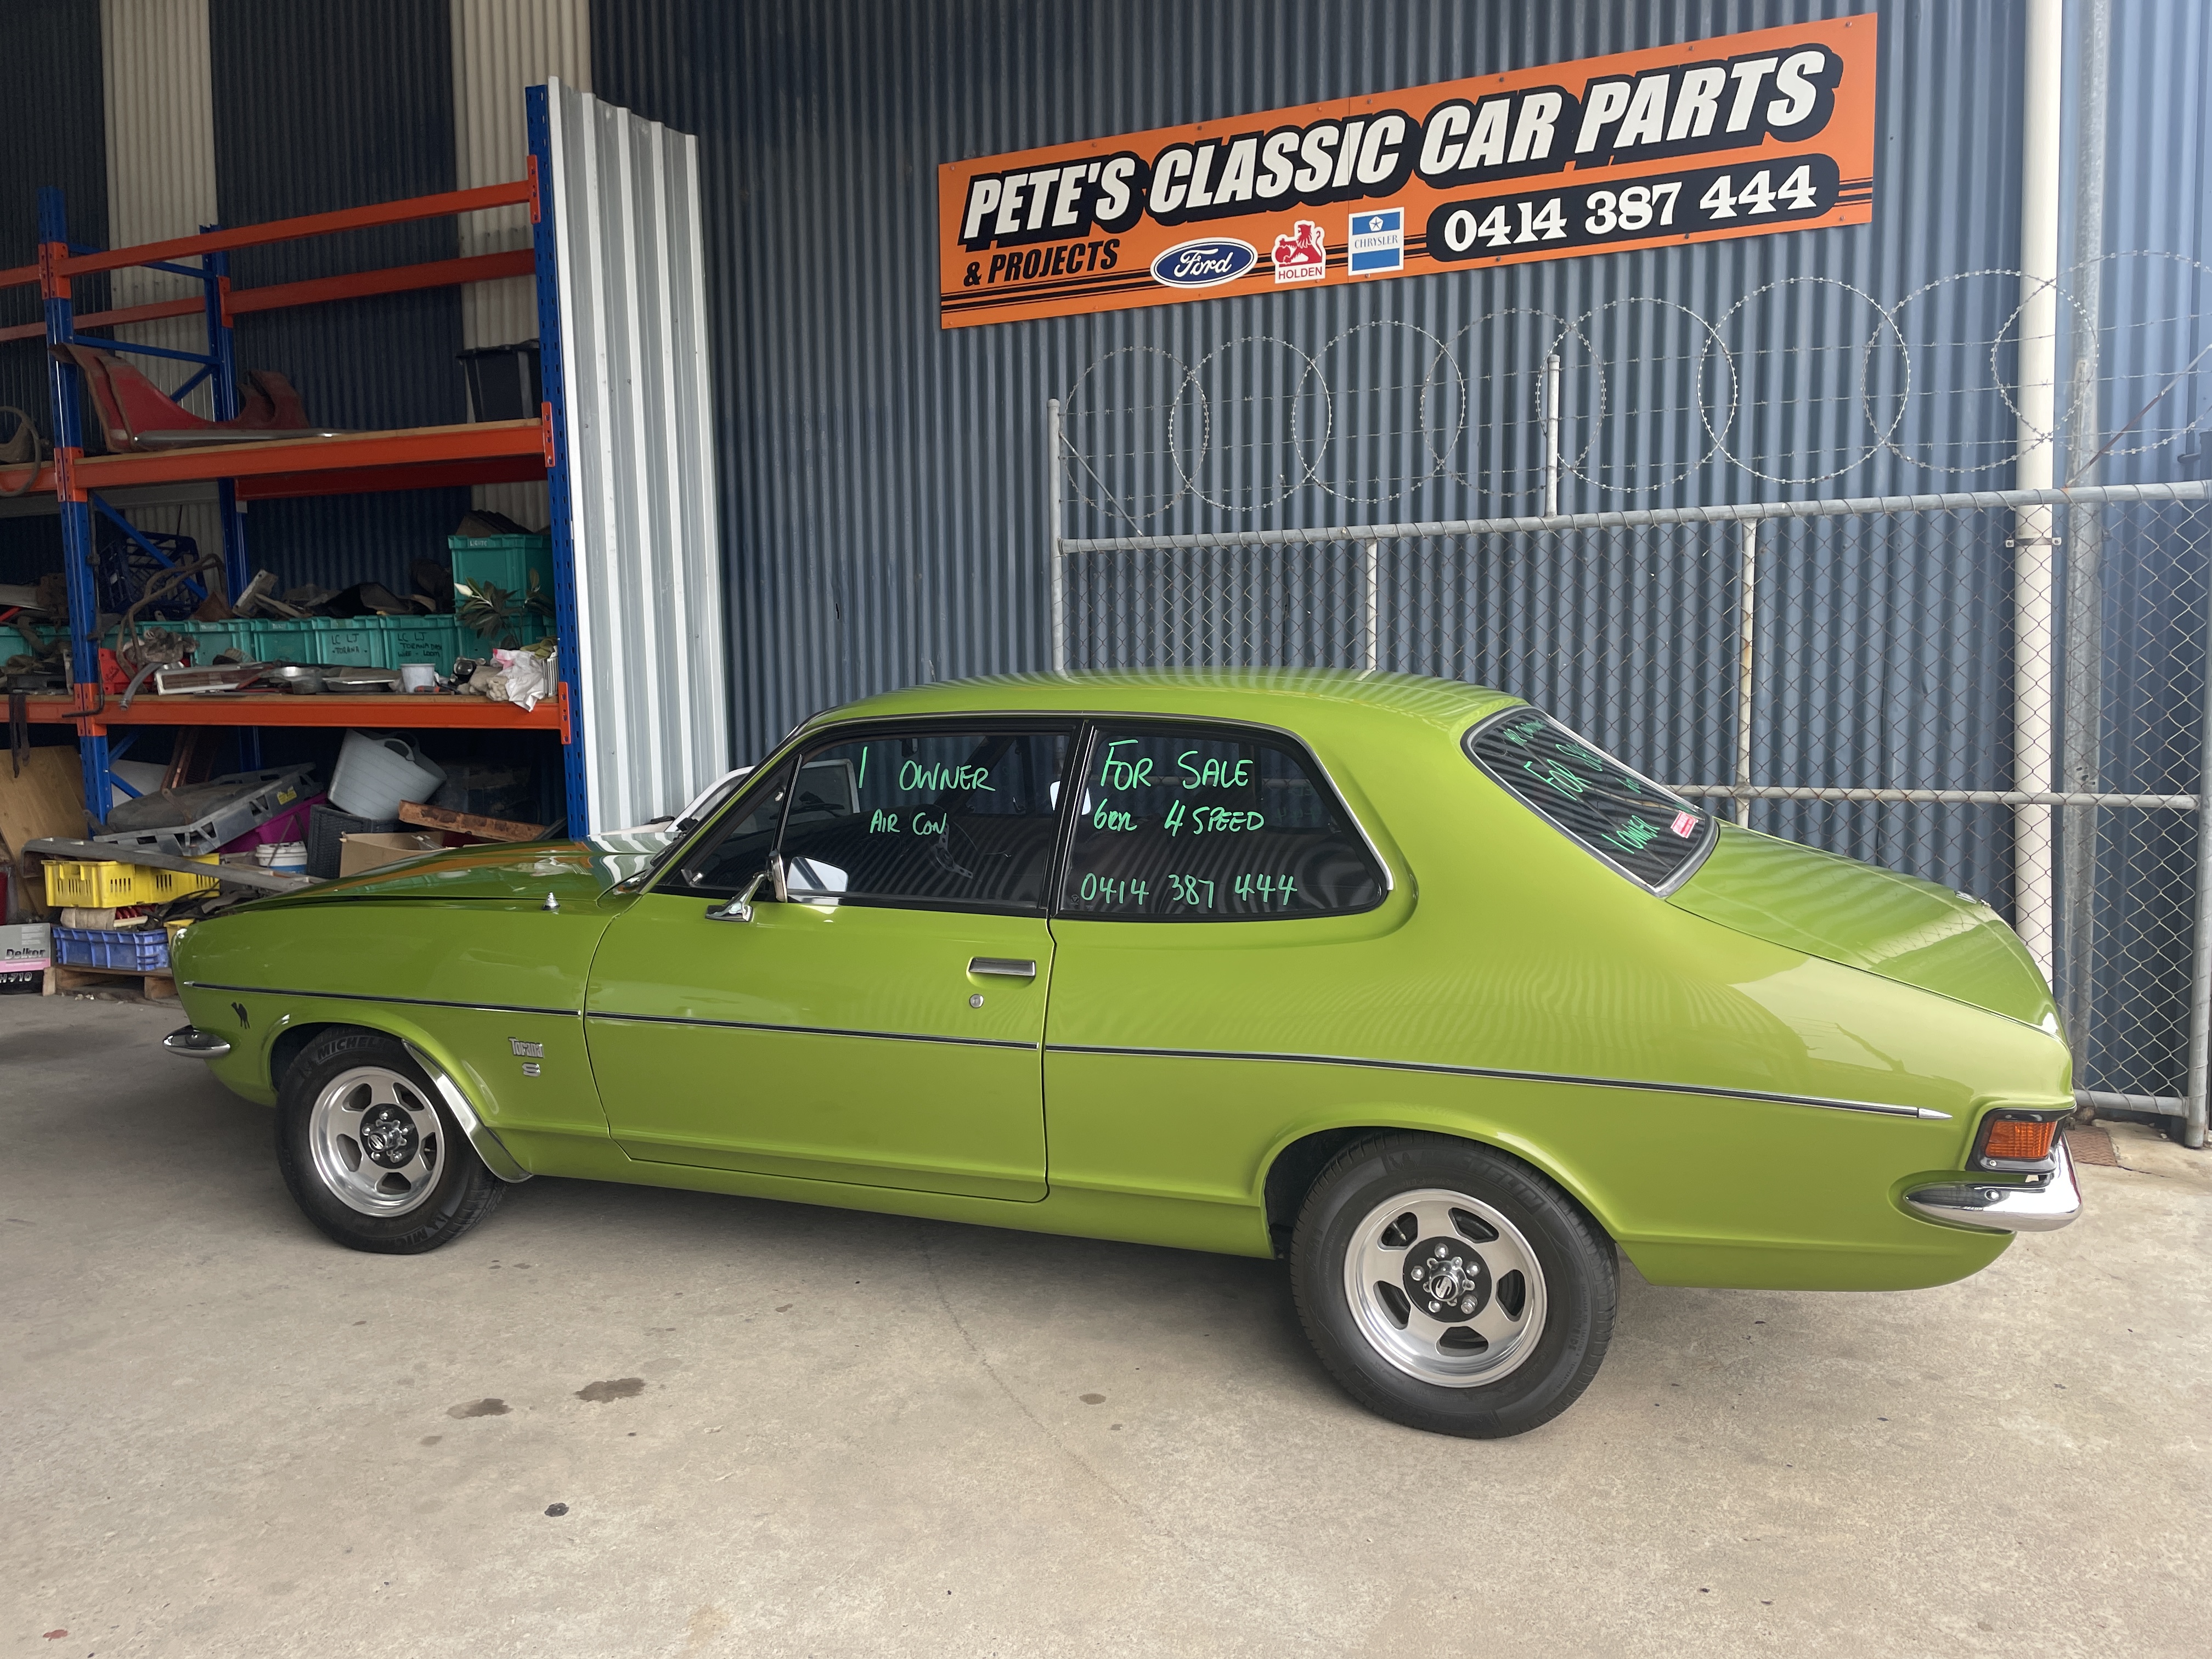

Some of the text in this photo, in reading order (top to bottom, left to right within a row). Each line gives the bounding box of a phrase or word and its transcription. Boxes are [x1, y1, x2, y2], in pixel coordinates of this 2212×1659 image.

[963, 50, 1826, 239] PETE'S CLASSIC CAR PARTS
[1443, 164, 1818, 252] 0414 387 444
[1354, 235, 1398, 249] CHRYSLER
[963, 238, 1120, 287] & PROJECTS
[1174, 248, 1233, 277] Ford
[1278, 266, 1323, 280] HOLDEN
[899, 760, 996, 791] OWNER
[1100, 739, 1253, 791] FOR SALE
[870, 809, 900, 833] AIR
[1164, 799, 1186, 837] 4
[1192, 806, 1265, 834] SPEED
[1080, 872, 1297, 909] 0414 387 444
[4, 947, 46, 960] Delkor
[317, 1036, 387, 1060] MICHEL
